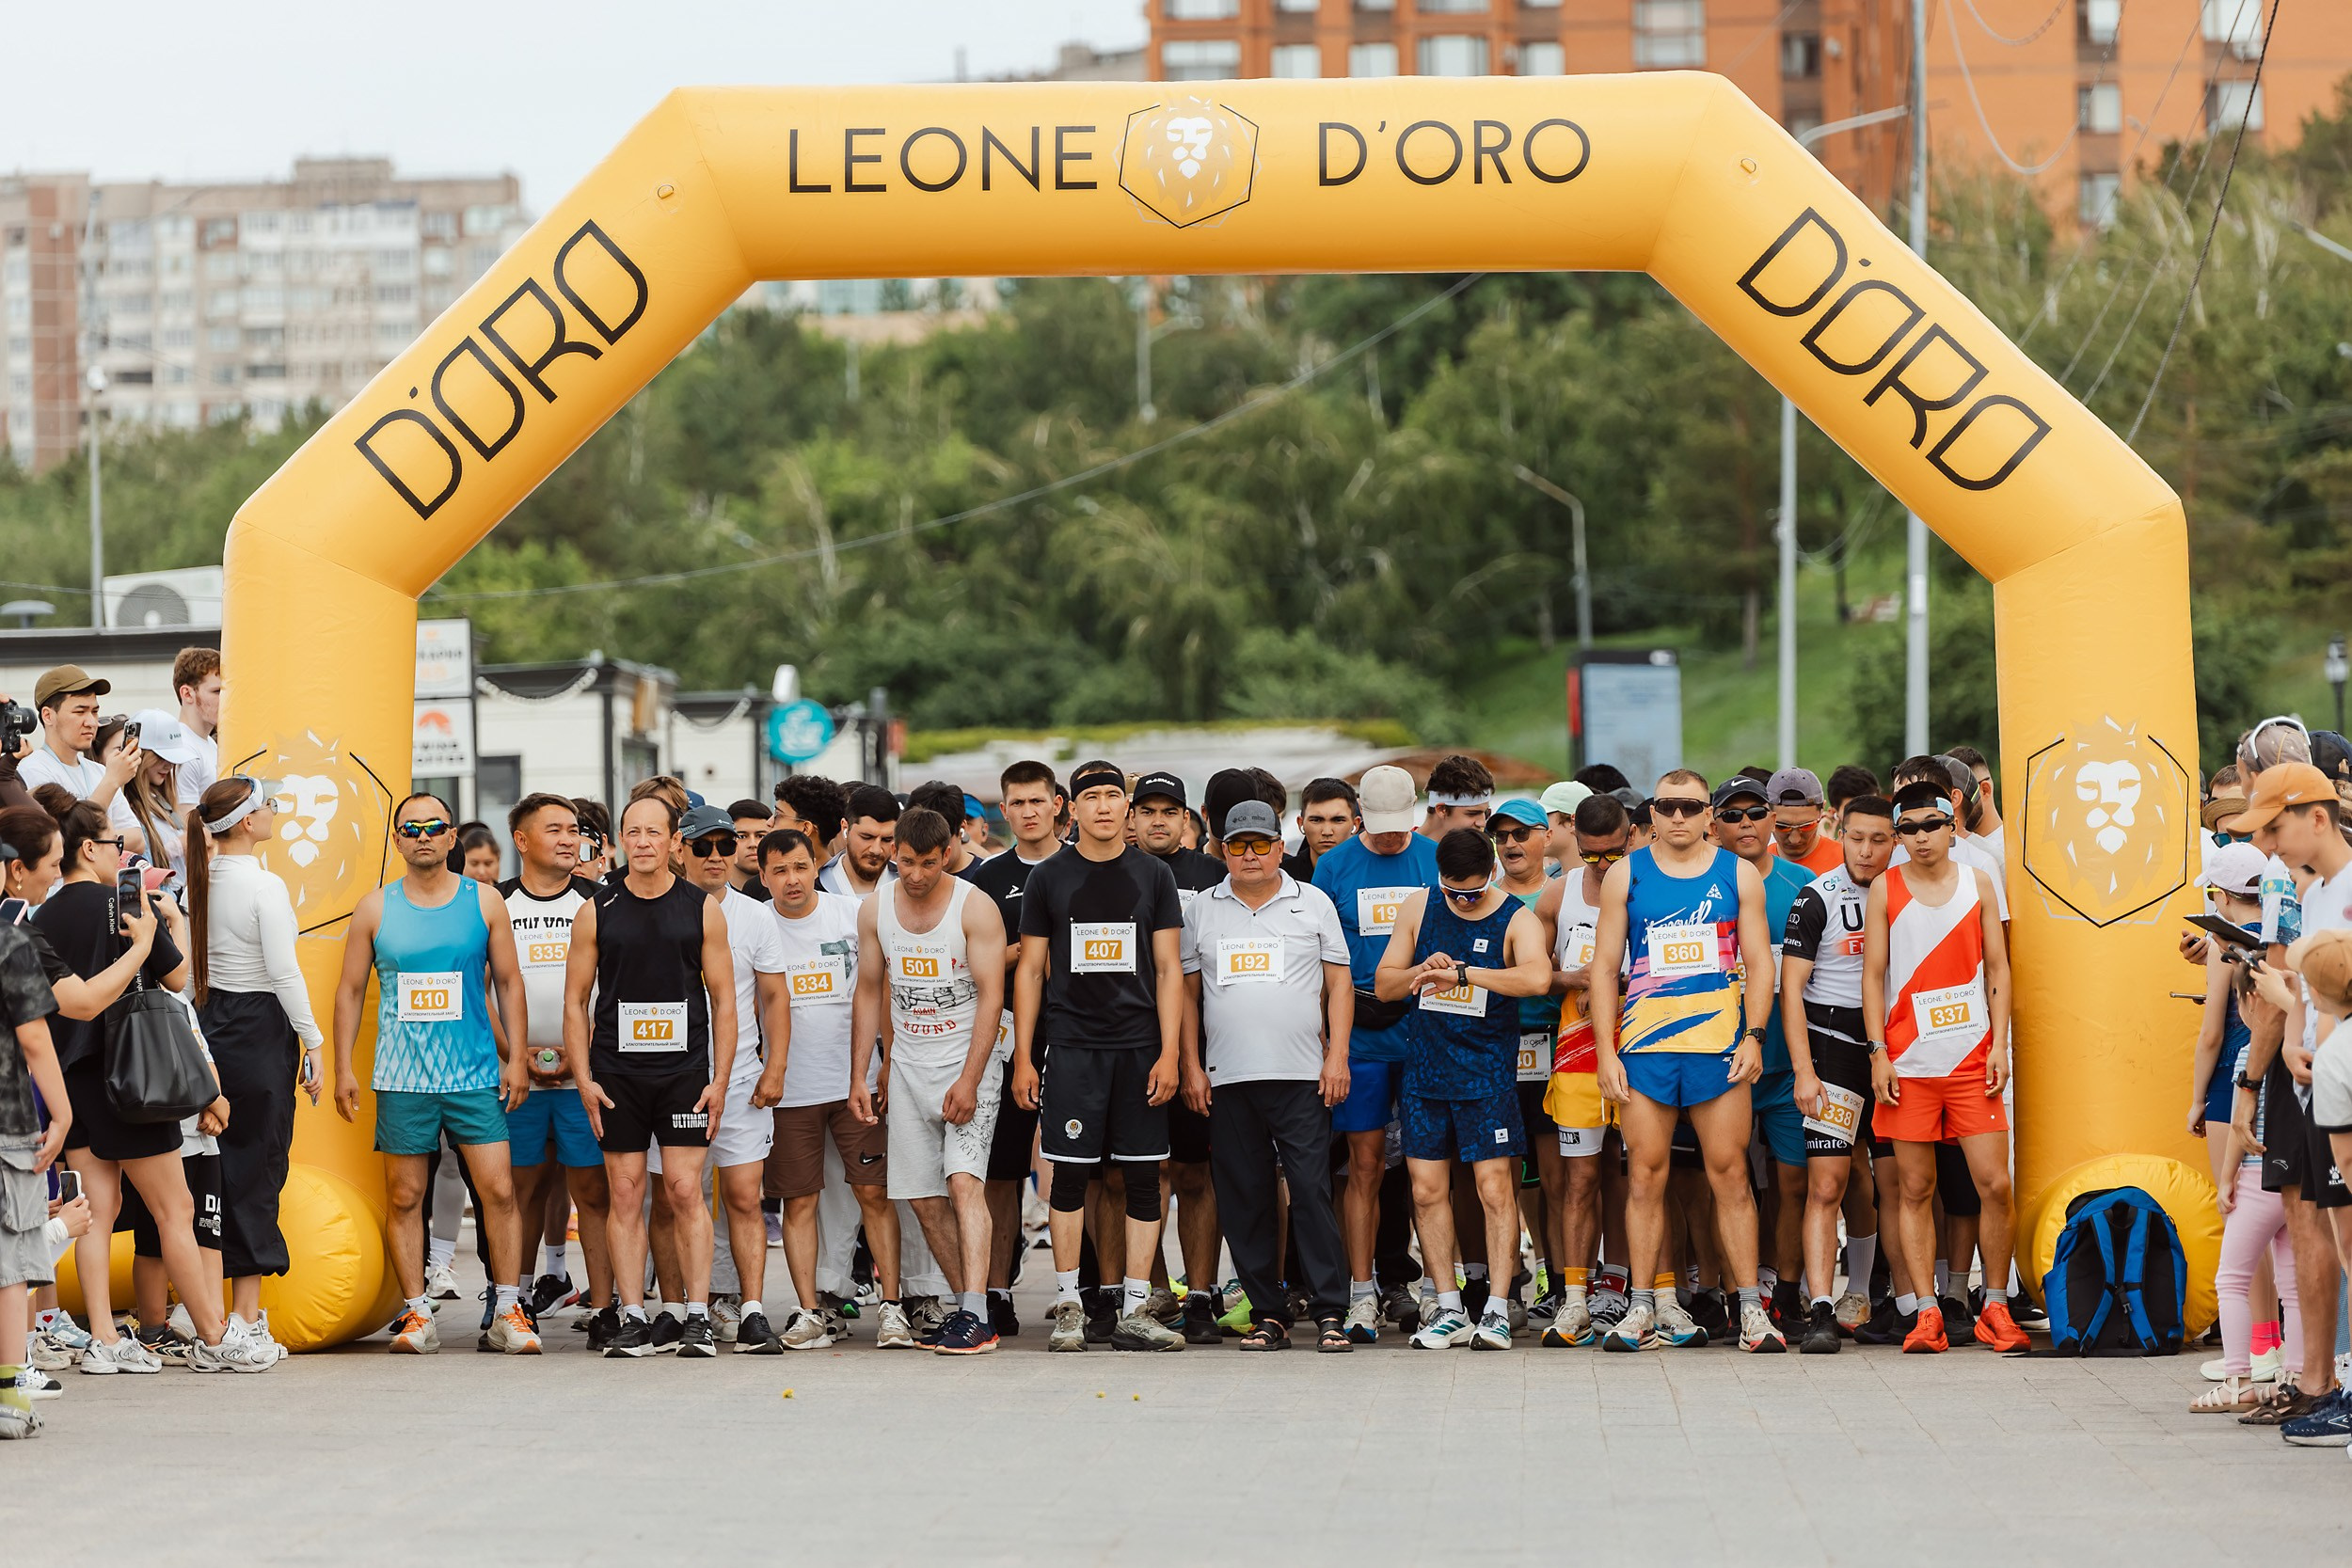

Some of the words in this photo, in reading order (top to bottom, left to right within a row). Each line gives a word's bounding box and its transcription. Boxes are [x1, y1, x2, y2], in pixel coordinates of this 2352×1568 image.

[788, 124, 1098, 194] LEONE
[1318, 118, 1591, 187] D'ORO
[215, 817, 233, 832] DIOR
[1363, 893, 1387, 901] LEONE
[1376, 905, 1397, 921] 19
[1653, 932, 1677, 941] LEONE
[532, 944, 564, 960] 335
[1088, 942, 1119, 958] 407
[1667, 943, 1700, 961] 360
[906, 959, 933, 974] 501
[1234, 955, 1266, 970] 192
[797, 974, 829, 992] 334
[414, 991, 445, 1007] 410
[1918, 995, 1943, 1006] LEONE
[1933, 1005, 1964, 1025] 337
[636, 1022, 669, 1037] 417
[903, 1020, 957, 1035] ROUND
[1826, 1089, 1841, 1100] ONE
[1823, 1104, 1852, 1127] 338
[1805, 1137, 1848, 1149] mirates
